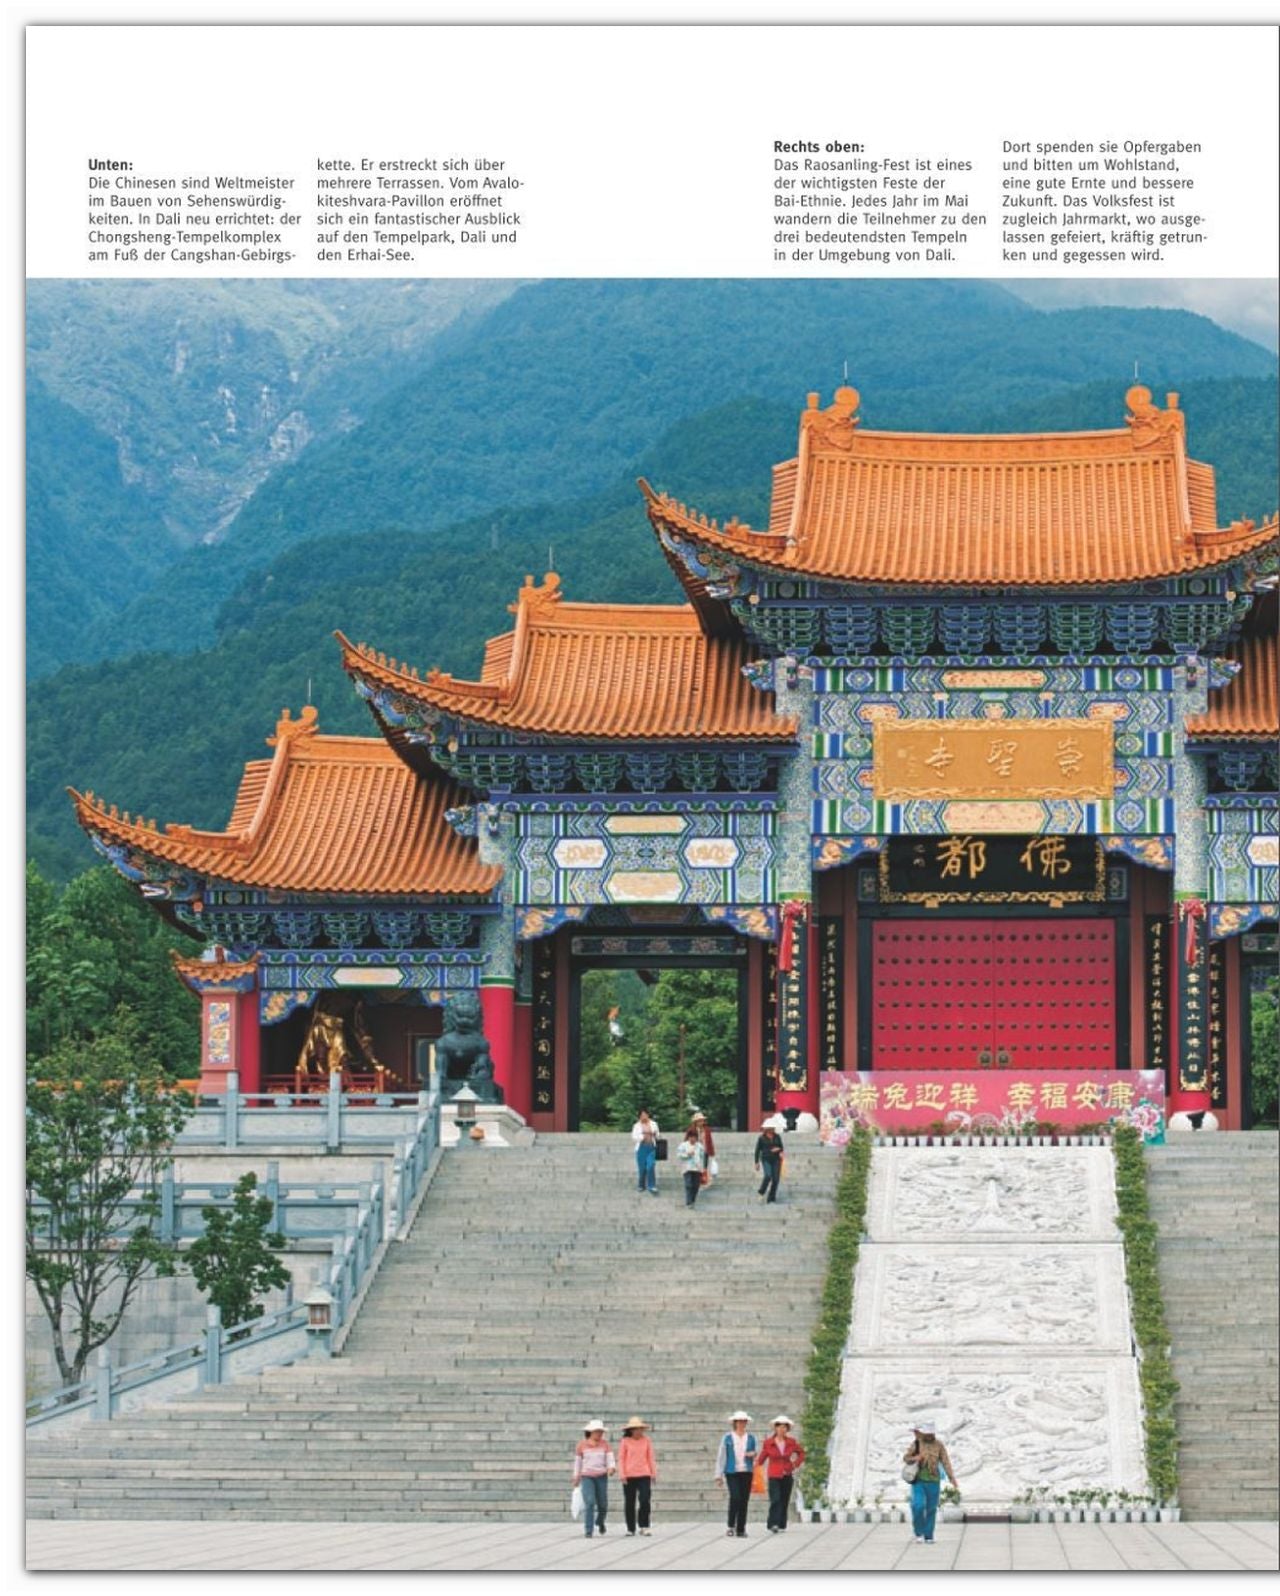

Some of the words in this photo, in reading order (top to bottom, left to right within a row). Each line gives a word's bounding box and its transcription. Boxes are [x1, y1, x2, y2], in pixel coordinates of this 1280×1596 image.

[773, 139, 821, 153] Rechts
[825, 139, 865, 153] oben:
[1003, 140, 1031, 153] Dort
[1036, 140, 1094, 156] spenden
[1099, 140, 1119, 153] sie
[1123, 140, 1202, 156] Opfergaben
[88, 158, 133, 171] Unten:
[317, 157, 355, 171] kette.
[361, 158, 374, 171] Er
[379, 158, 437, 171] erstreckt
[442, 158, 469, 171] sich
[474, 158, 505, 171] über
[774, 158, 799, 171] Das
[804, 158, 910, 174] Raosanling-Fest
[915, 158, 932, 171] ist
[936, 158, 973, 171] eines
[1003, 158, 1028, 171] und
[1033, 157, 1073, 171] bitten
[1078, 161, 1099, 171] um
[1103, 158, 1180, 172] Wohlstand,
[89, 176, 110, 189] Die
[115, 176, 176, 189] Chinesen
[181, 176, 210, 189] sind
[214, 176, 295, 190] Weltmeister
[317, 176, 372, 190] mehrere
[376, 176, 444, 190] Terrassen.
[449, 176, 479, 189] Vom
[482, 176, 524, 190] Avalo-
[774, 176, 796, 189] der
[800, 176, 878, 192] wichtigsten
[883, 176, 918, 189] Feste
[923, 176, 946, 189] der
[317, 194, 444, 208] kiteshvara-Pavillon
[449, 193, 502, 208] eröffnet
[774, 194, 846, 207] Bai-Ethnie.
[851, 194, 887, 209] Jedes
[892, 194, 918, 209] Jahr
[923, 194, 939, 207] im
[945, 194, 969, 207] Mai
[1002, 193, 1057, 208] Zukunft.
[1063, 194, 1088, 207] Das
[1092, 194, 1153, 208] Volksfest
[1158, 194, 1175, 208] ist
[88, 212, 133, 225] keiten.
[138, 213, 150, 224] In
[156, 212, 181, 225] Dali
[186, 215, 210, 225] neu
[215, 212, 274, 225] errichtet:
[279, 212, 302, 225] der
[1002, 212, 1057, 228] zugleich
[1062, 212, 1131, 227] Jahrmarkt,
[1135, 215, 1156, 225] wo
[1161, 215, 1205, 228] ausge-
[88, 230, 281, 246] Chongsheng-Tempelkomplex
[317, 230, 340, 244] auf
[343, 230, 368, 243] den
[373, 230, 455, 246] Tempelpark,
[460, 230, 486, 243] Dali
[491, 230, 517, 244] und
[774, 230, 800, 243] drei
[805, 230, 906, 243] bedeutendsten
[911, 230, 967, 246] Tempeln
[1002, 230, 1045, 243] lassen
[1050, 230, 1106, 246] gefeiert,
[1111, 230, 1154, 246] kräftig
[1159, 231, 1207, 246] getrun-
[88, 251, 109, 261] am
[114, 248, 139, 261] Fuß
[143, 248, 166, 261] der
[170, 248, 296, 264] Cangshan-Gebirgs-
[317, 248, 342, 261] den
[347, 248, 415, 261] Erhai-See.
[774, 248, 786, 261] in
[791, 248, 814, 261] der
[818, 248, 891, 264] Umgebung
[895, 251, 920, 261] von
[925, 248, 956, 261] Dali.
[1002, 248, 1027, 261] ken
[1032, 248, 1058, 261] und
[1063, 251, 1126, 264] gegessen
[1130, 248, 1164, 261] wird.
[1007, 1081, 1135, 1110] 幸福安康
